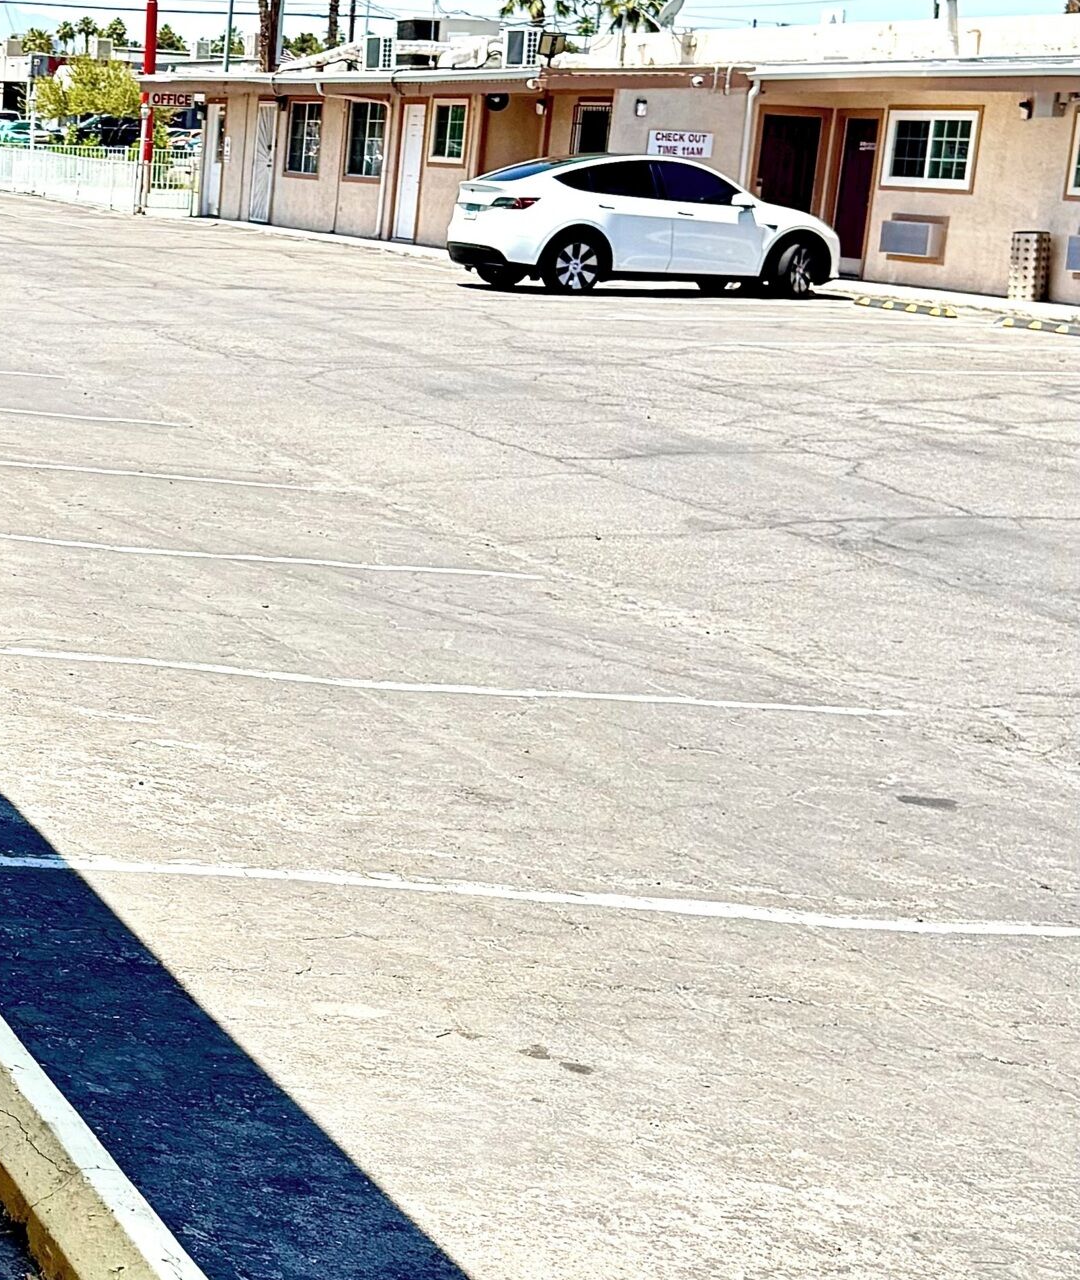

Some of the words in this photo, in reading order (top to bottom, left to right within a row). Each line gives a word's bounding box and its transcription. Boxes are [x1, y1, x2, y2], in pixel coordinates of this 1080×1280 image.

[153, 93, 192, 105] OFFICE
[655, 132, 685, 142] CHECK
[688, 134, 707, 143] OUT
[657, 145, 677, 155] TIME
[682, 147, 703, 156] 11AM
